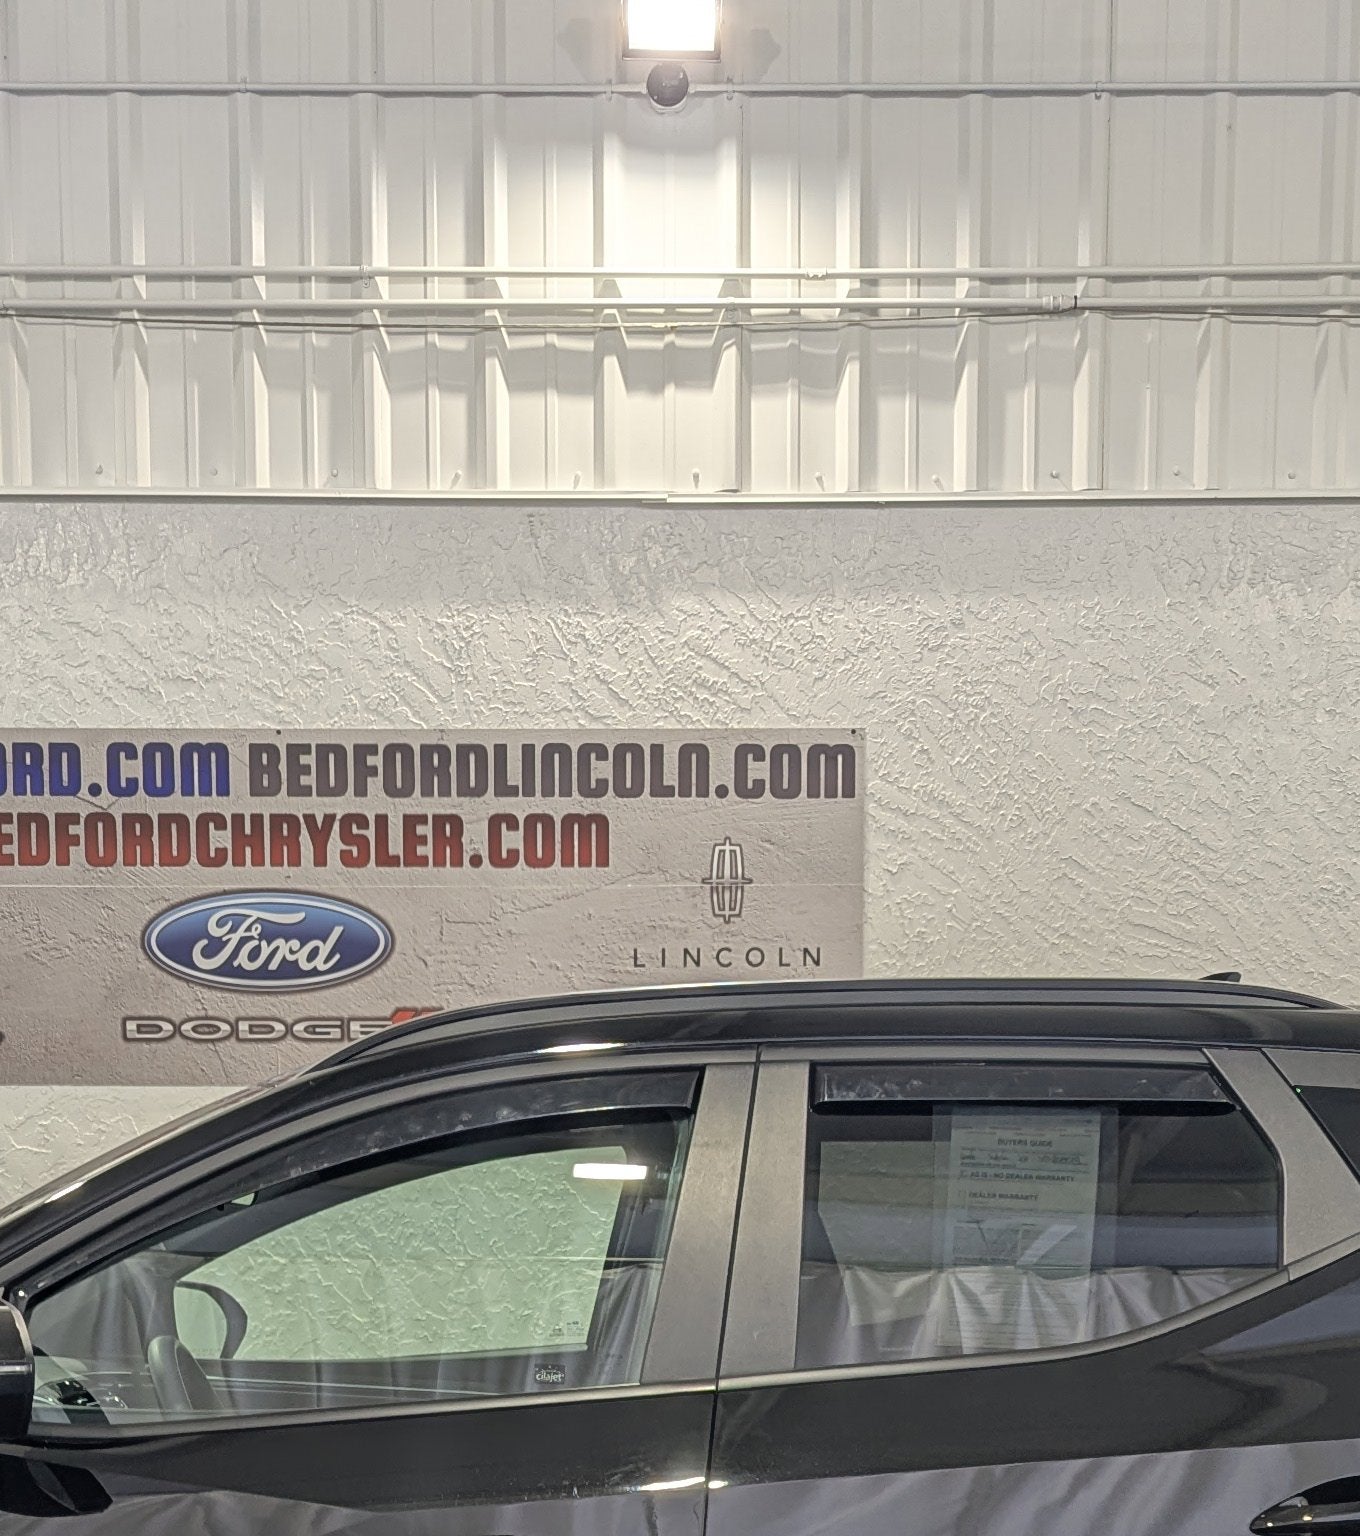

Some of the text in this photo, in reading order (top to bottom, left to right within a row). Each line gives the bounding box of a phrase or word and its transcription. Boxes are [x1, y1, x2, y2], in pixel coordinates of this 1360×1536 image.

[248, 742, 857, 799] BEDFORDLINCOLN.COM
[192, 908, 344, 972] Ford
[633, 946, 822, 968] LINCOLN
